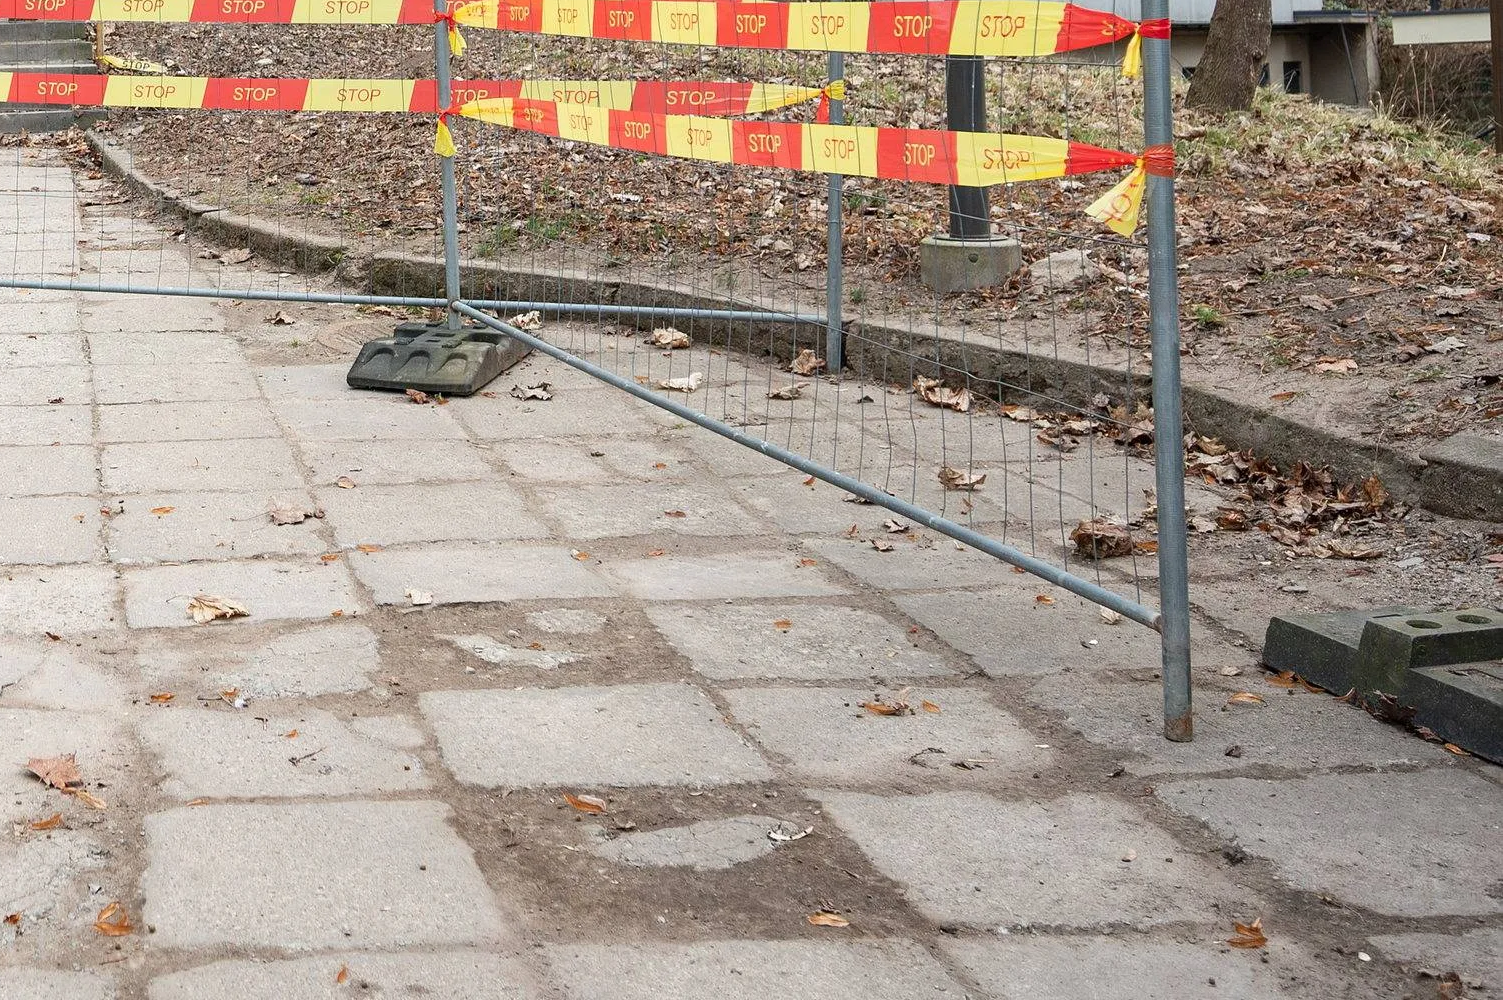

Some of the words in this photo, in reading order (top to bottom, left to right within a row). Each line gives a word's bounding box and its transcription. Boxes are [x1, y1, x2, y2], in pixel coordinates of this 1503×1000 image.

[122, 0, 164, 13] STOP
[221, 0, 265, 14] STOP
[325, 1, 369, 14] STOP
[510, 6, 530, 21] STOP
[557, 8, 578, 24] STOP
[609, 10, 635, 27] STOP
[670, 13, 698, 31] STOP
[736, 15, 767, 33] STOP
[811, 15, 844, 35] STOP
[894, 15, 933, 37] STOP
[981, 15, 1025, 38] STOP
[123, 60, 151, 70] STOP
[37, 82, 78, 96] STOP
[134, 85, 176, 99] STOP
[233, 87, 276, 101] STOP
[337, 88, 380, 102] STOP
[552, 89, 599, 105] STOP
[666, 90, 715, 105] STOP
[570, 113, 593, 130] STOP
[624, 121, 651, 139] STOP
[687, 128, 713, 146] STOP
[749, 133, 781, 152] STOP
[824, 138, 855, 159] STOP
[902, 143, 935, 166] STOP
[983, 148, 1030, 169] STOP
